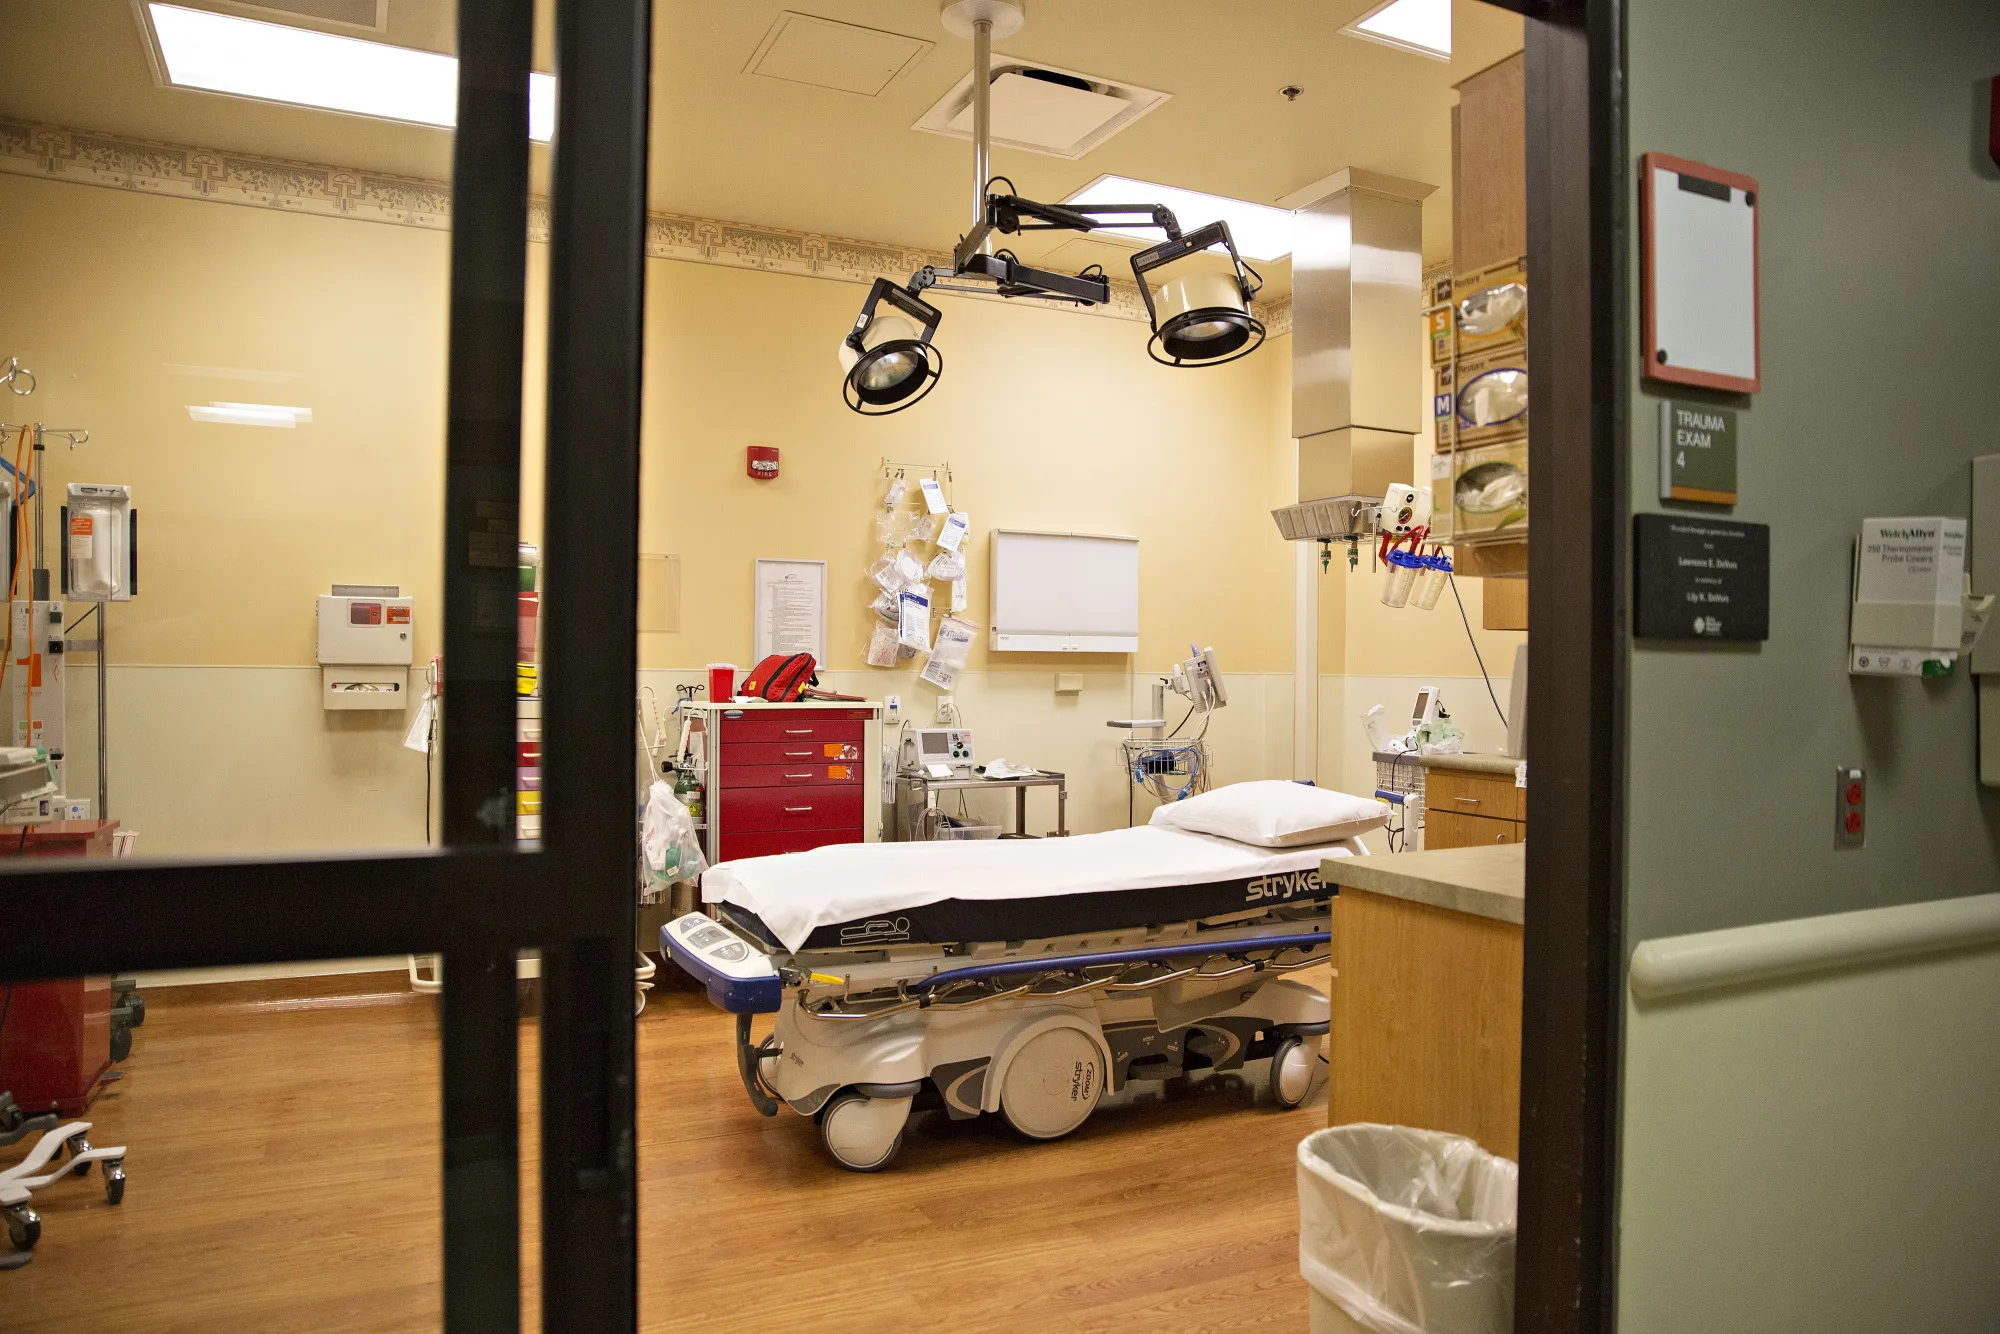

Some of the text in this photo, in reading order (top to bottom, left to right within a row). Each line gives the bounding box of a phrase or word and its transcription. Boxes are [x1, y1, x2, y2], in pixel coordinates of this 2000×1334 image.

[1435, 312, 1445, 330] S
[1437, 395, 1450, 415] M
[1677, 409, 1725, 432] TRAUMA
[1677, 429, 1711, 449] EXAM
[1676, 450, 1685, 468] 4
[1071, 1060, 1083, 1102] stryker
